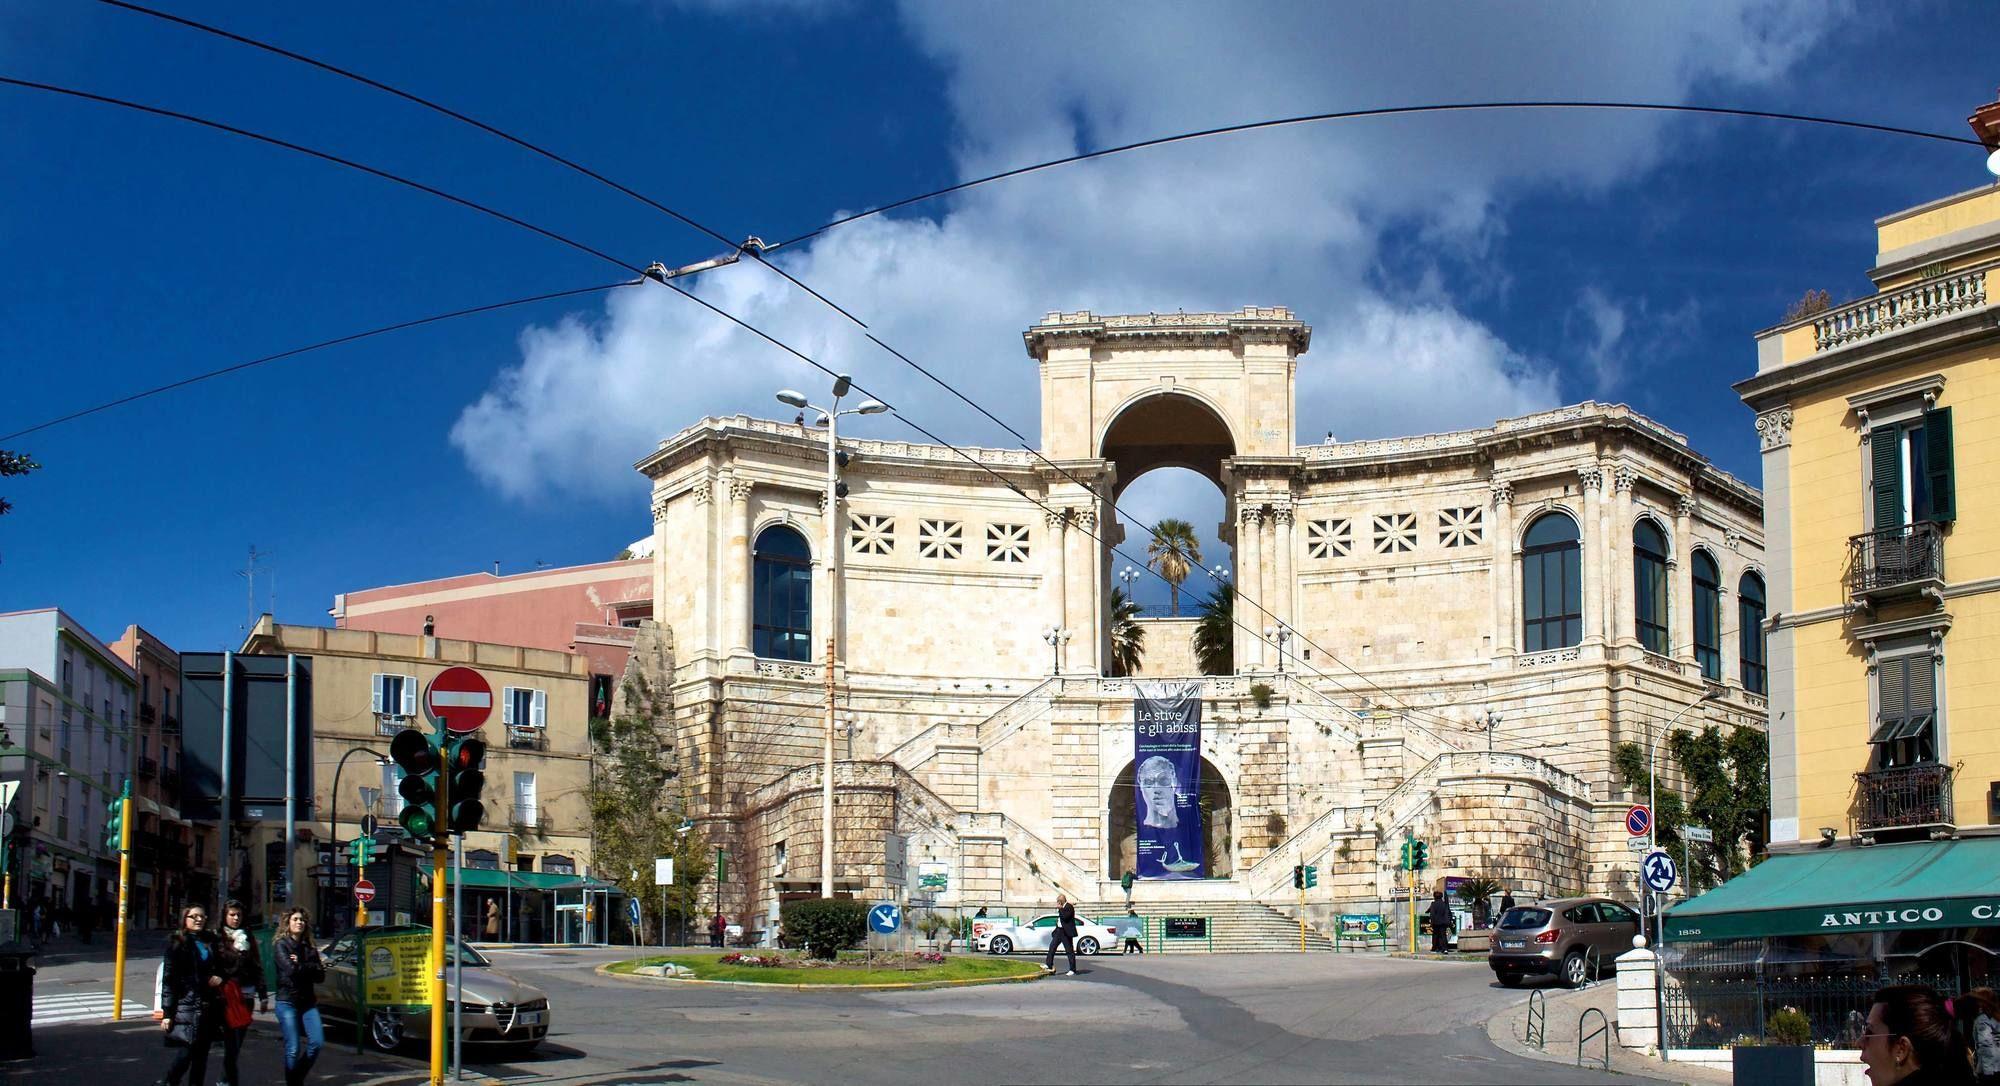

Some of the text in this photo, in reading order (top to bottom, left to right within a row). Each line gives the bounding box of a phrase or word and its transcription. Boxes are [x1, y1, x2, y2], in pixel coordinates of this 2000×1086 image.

[1139, 710, 1182, 721] Le stive
[1138, 721, 1198, 737] e gli abissi
[1820, 907, 1943, 927] ANTICO
[1678, 928, 1701, 936] 1855
